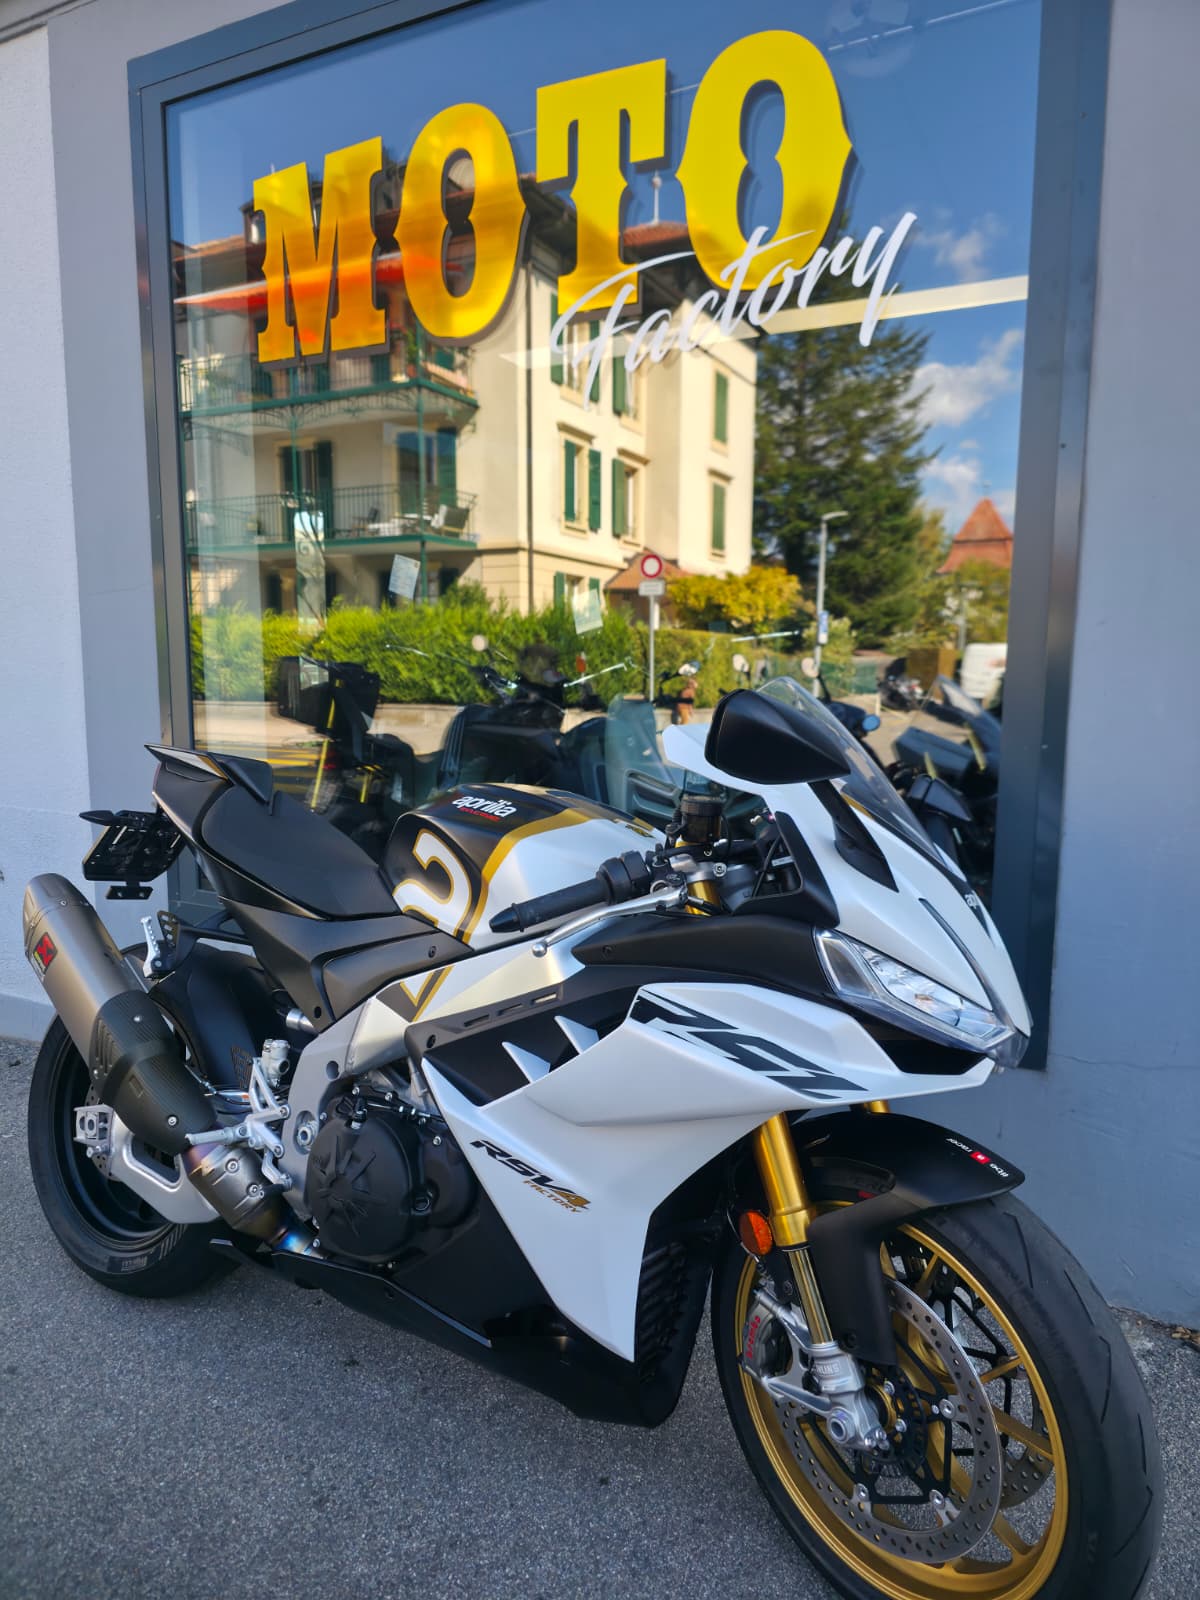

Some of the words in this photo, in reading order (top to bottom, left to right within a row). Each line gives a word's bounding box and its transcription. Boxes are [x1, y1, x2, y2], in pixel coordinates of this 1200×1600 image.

[253, 29, 853, 363] MOTO
[550, 211, 918, 411] Factory
[452, 796, 517, 818] aprilia
[469, 1139, 591, 1210] RSV4
